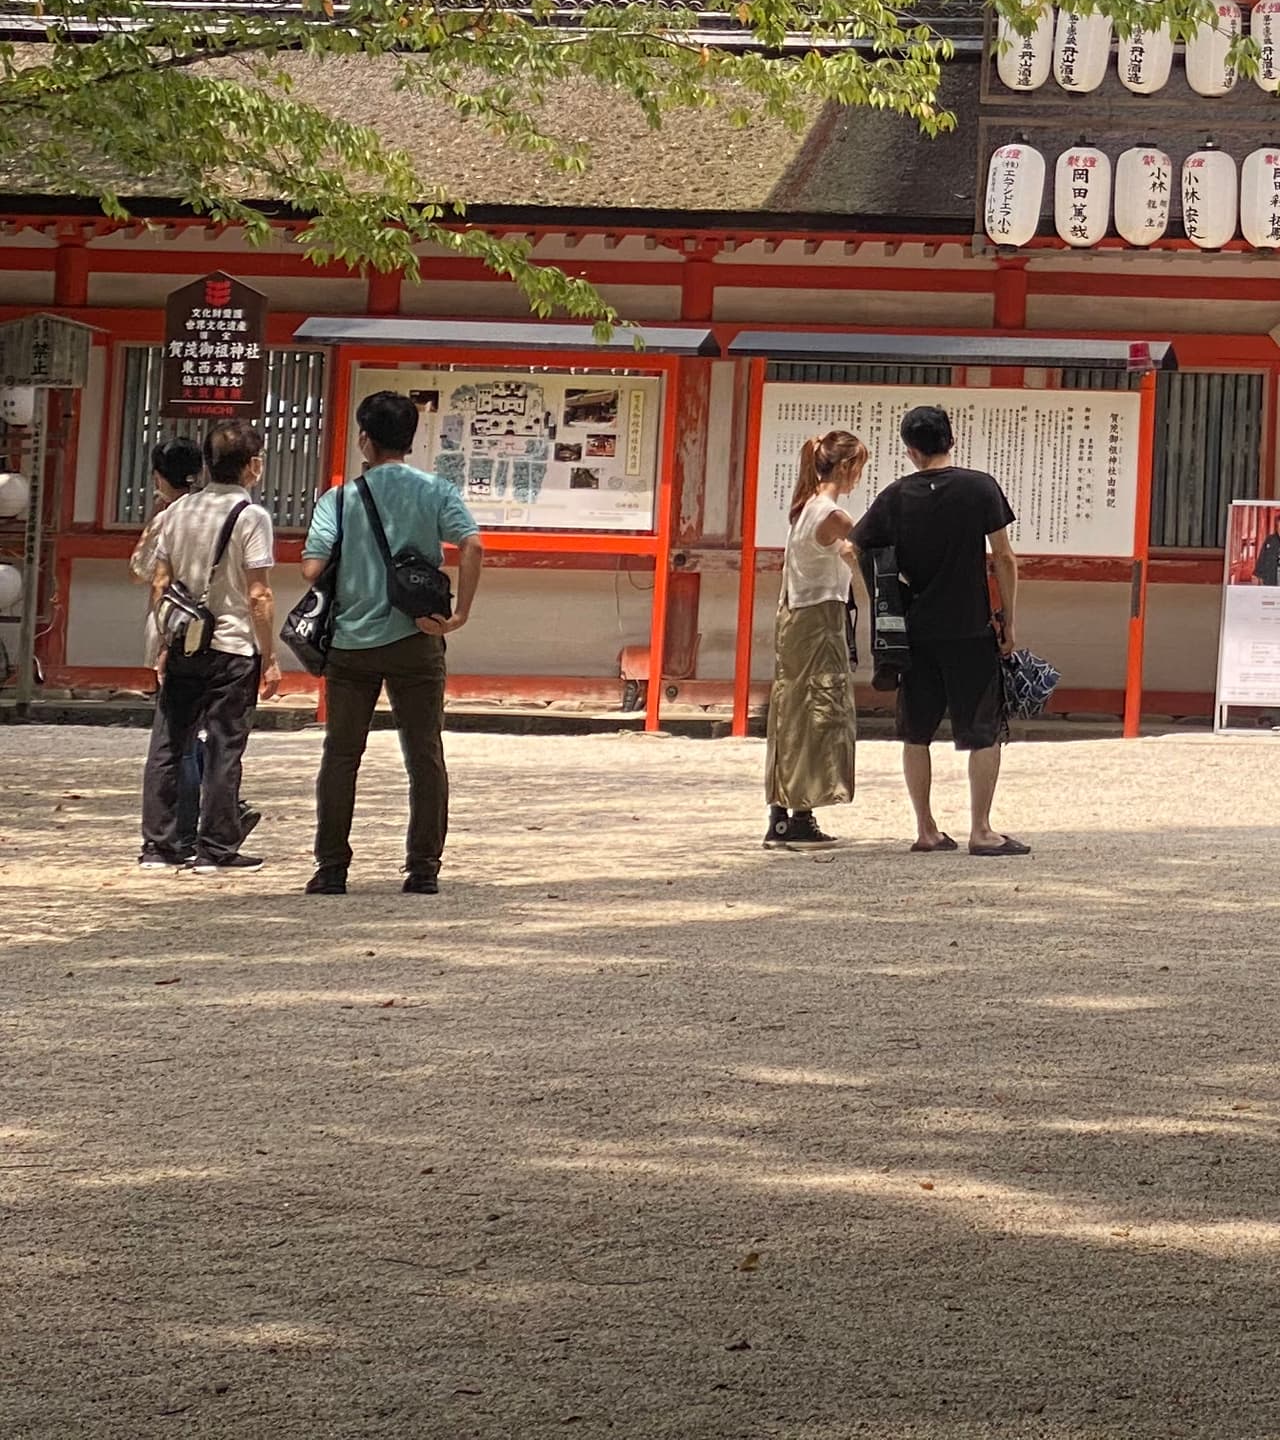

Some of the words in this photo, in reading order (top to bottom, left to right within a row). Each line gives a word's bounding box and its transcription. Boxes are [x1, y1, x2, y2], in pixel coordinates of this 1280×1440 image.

[1015, 50, 1036, 88] 丹山酒造
[1059, 46, 1079, 86] 丹山酒造
[1127, 46, 1145, 85] 丹山酒造
[1261, 46, 1276, 81] 丹山酒造
[1150, 167, 1167, 193] 小林
[1069, 168, 1089, 240] 岡田篤哉
[1182, 171, 1207, 240] 小林宏史
[185, 320, 247, 332] 世界文化遺産
[169, 340, 261, 360] 賀茂御祖神社
[181, 361, 245, 375] 東西本殿
